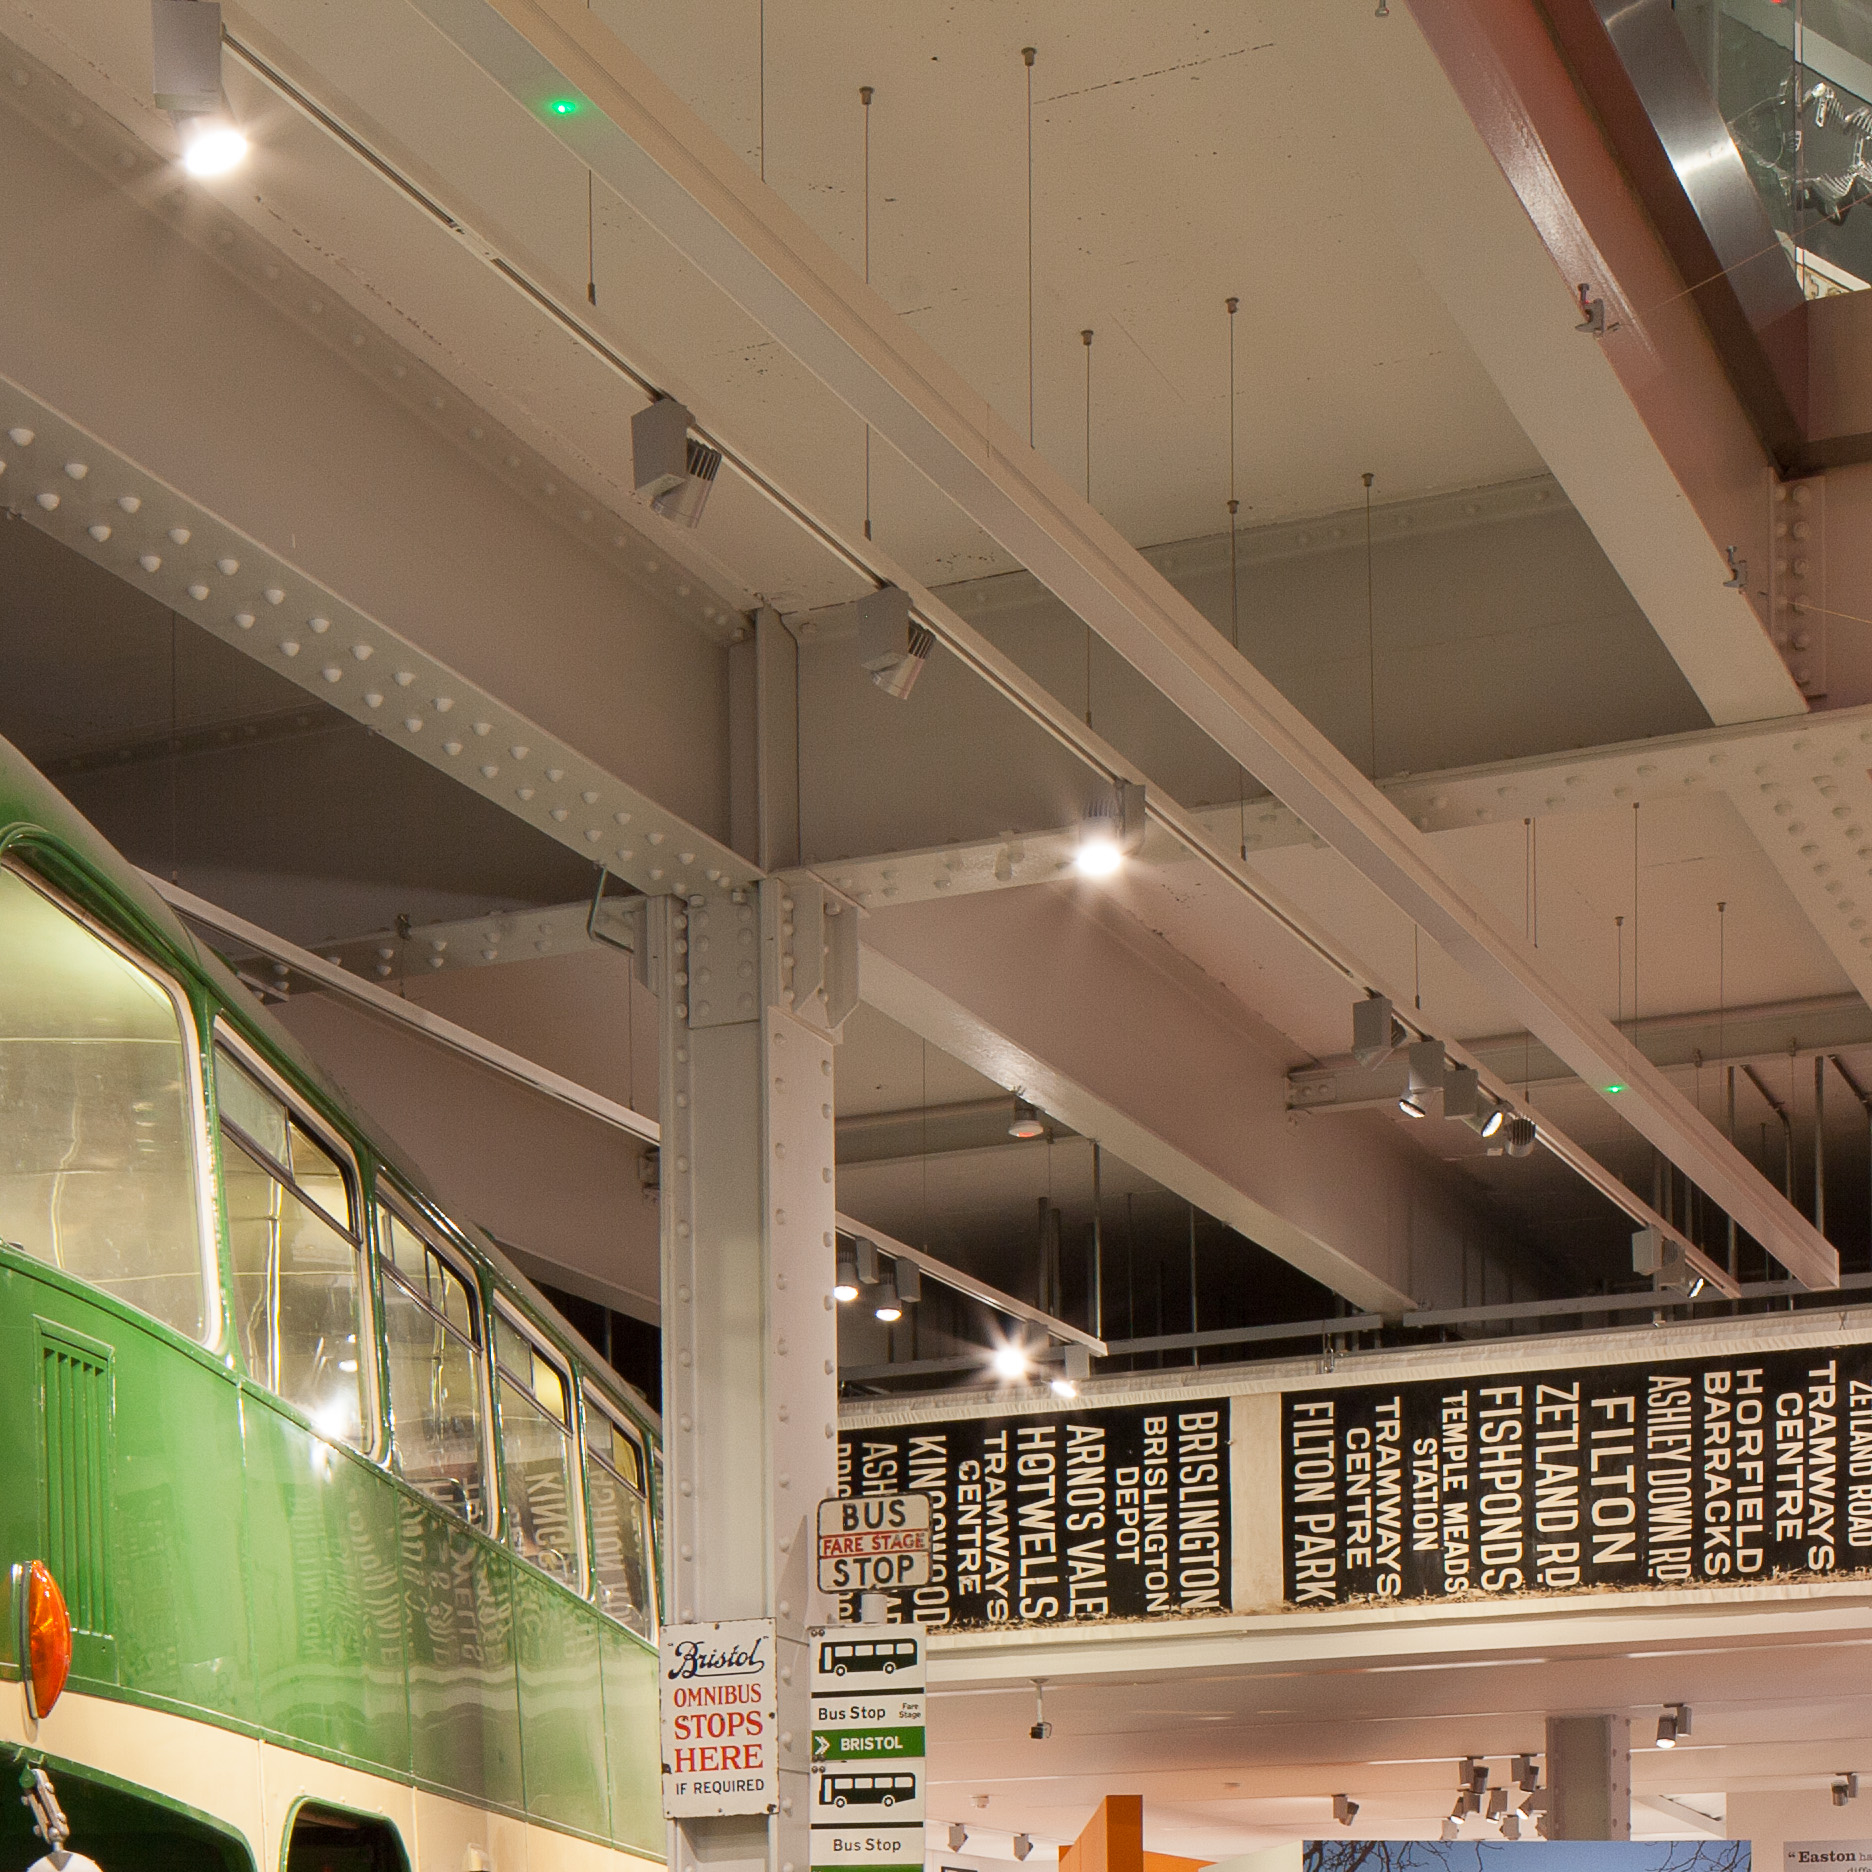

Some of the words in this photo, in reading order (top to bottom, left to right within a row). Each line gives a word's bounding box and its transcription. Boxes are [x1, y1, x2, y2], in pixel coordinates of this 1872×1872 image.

[1293, 1402, 1335, 1504] FILTON
[1443, 1391, 1467, 1492] TEMPLE
[1536, 1382, 1579, 1533] ZETLAND
[1647, 1376, 1691, 1462] ASHLEY
[1774, 1392, 1802, 1541] CENTRE
[1808, 1360, 1834, 1571] TRAMWAYS
[842, 1499, 906, 1531] BUS
[1066, 1424, 1105, 1531] ARNO'S
[1116, 1468, 1139, 1565] DEPOT
[1144, 1417, 1169, 1612] BRISLINGTON
[1179, 1412, 1220, 1609] BRISLINGTON
[1346, 1428, 1371, 1569] CENTRE
[1375, 1396, 1401, 1596] TRAMWAYS
[1412, 1437, 1438, 1550] STATION
[1479, 1386, 1522, 1590] FISHPONDS
[1590, 1396, 1635, 1564] FILTON
[1647, 1467, 1692, 1542] DOWN
[1703, 1372, 1730, 1576] BARRACKS
[1735, 1368, 1763, 1574] HORFIELD
[823, 1536, 863, 1556] FARE
[872, 1532, 925, 1552] STAGE
[833, 1554, 913, 1587] STOP
[909, 1435, 950, 1625] KINOD
[959, 1461, 981, 1596] CENTRE
[984, 1431, 1009, 1621] TRAMWAYS
[1017, 1425, 1058, 1619] HOTWELLS
[1294, 1515, 1335, 1602] PARK
[1444, 1503, 1468, 1593] MEADS
[1537, 1544, 1580, 1588] RD
[1648, 1547, 1691, 1580] RD
[1069, 1539, 1108, 1617] VALE
[674, 1684, 762, 1707] OMNIBUS
[675, 1711, 763, 1740] STOPS
[818, 1707, 846, 1721] Bus
[850, 1705, 886, 1723] Stop
[841, 1737, 903, 1751] BRISTOL
[899, 1711, 921, 1720] Stage
[675, 1744, 764, 1774] HERE
[676, 1782, 687, 1795] IF
[694, 1778, 765, 1795] REQUIRED
[833, 1839, 861, 1852] Bus
[865, 1837, 901, 1855] Stop
